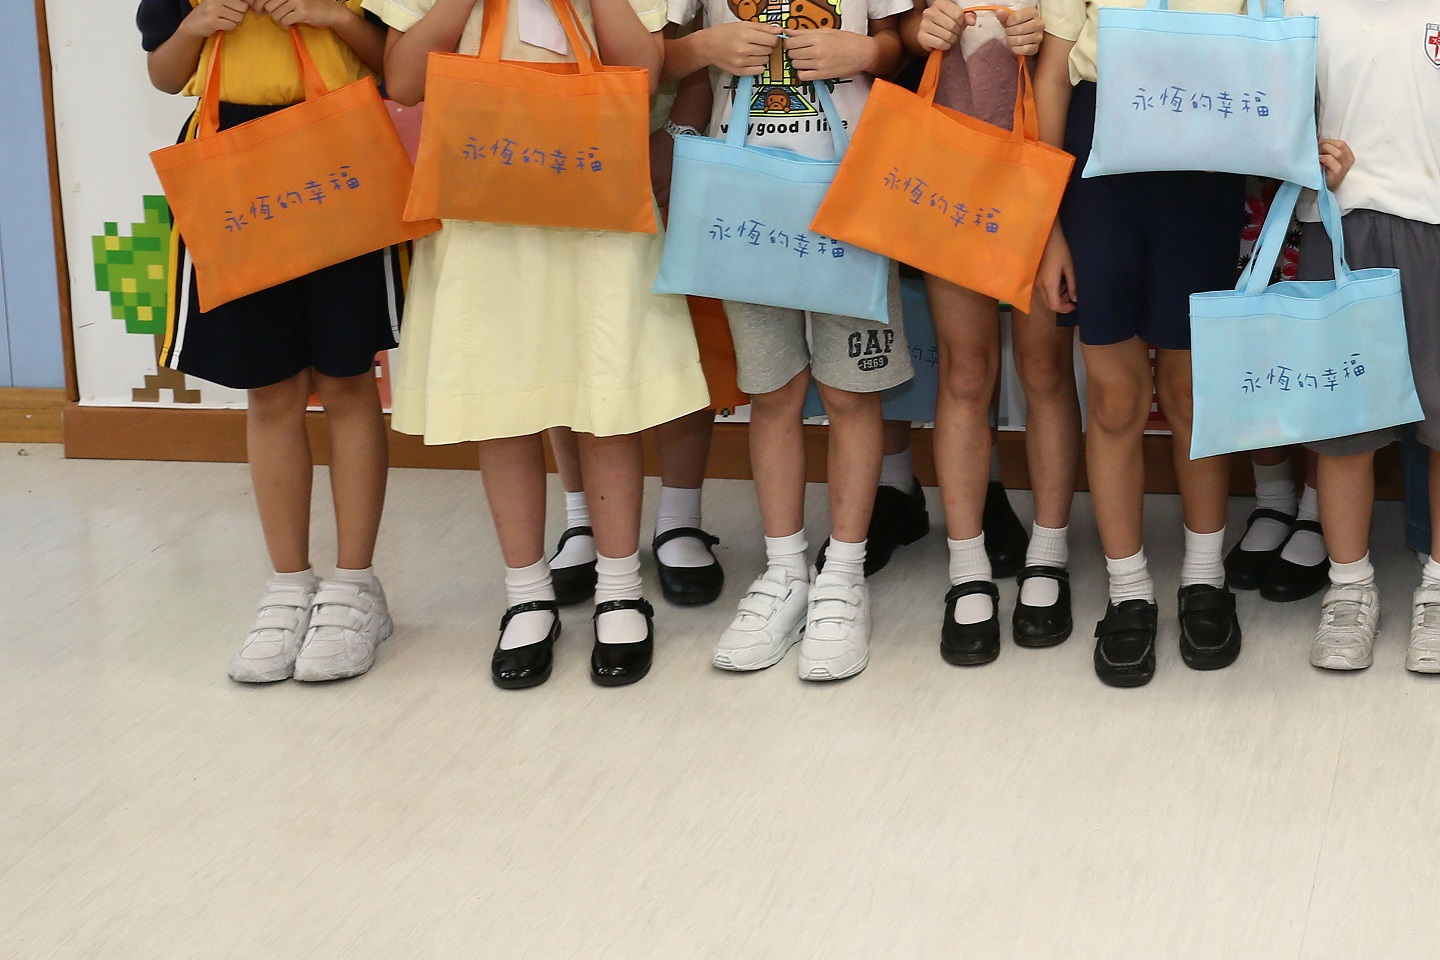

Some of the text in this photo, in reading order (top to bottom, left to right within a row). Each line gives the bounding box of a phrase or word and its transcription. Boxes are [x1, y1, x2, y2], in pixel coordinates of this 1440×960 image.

[1132, 86, 1269, 118] 永恆的幸福
[756, 120, 799, 136] good
[806, 120, 810, 132] I
[817, 118, 848, 132] lie
[462, 137, 602, 174] 永恆的幸福
[225, 165, 360, 232] 永恆的幸福
[884, 167, 1002, 233] 永恆的幸福
[847, 329, 894, 358] GAP
[1242, 353, 1365, 393] 永恆的幸福
